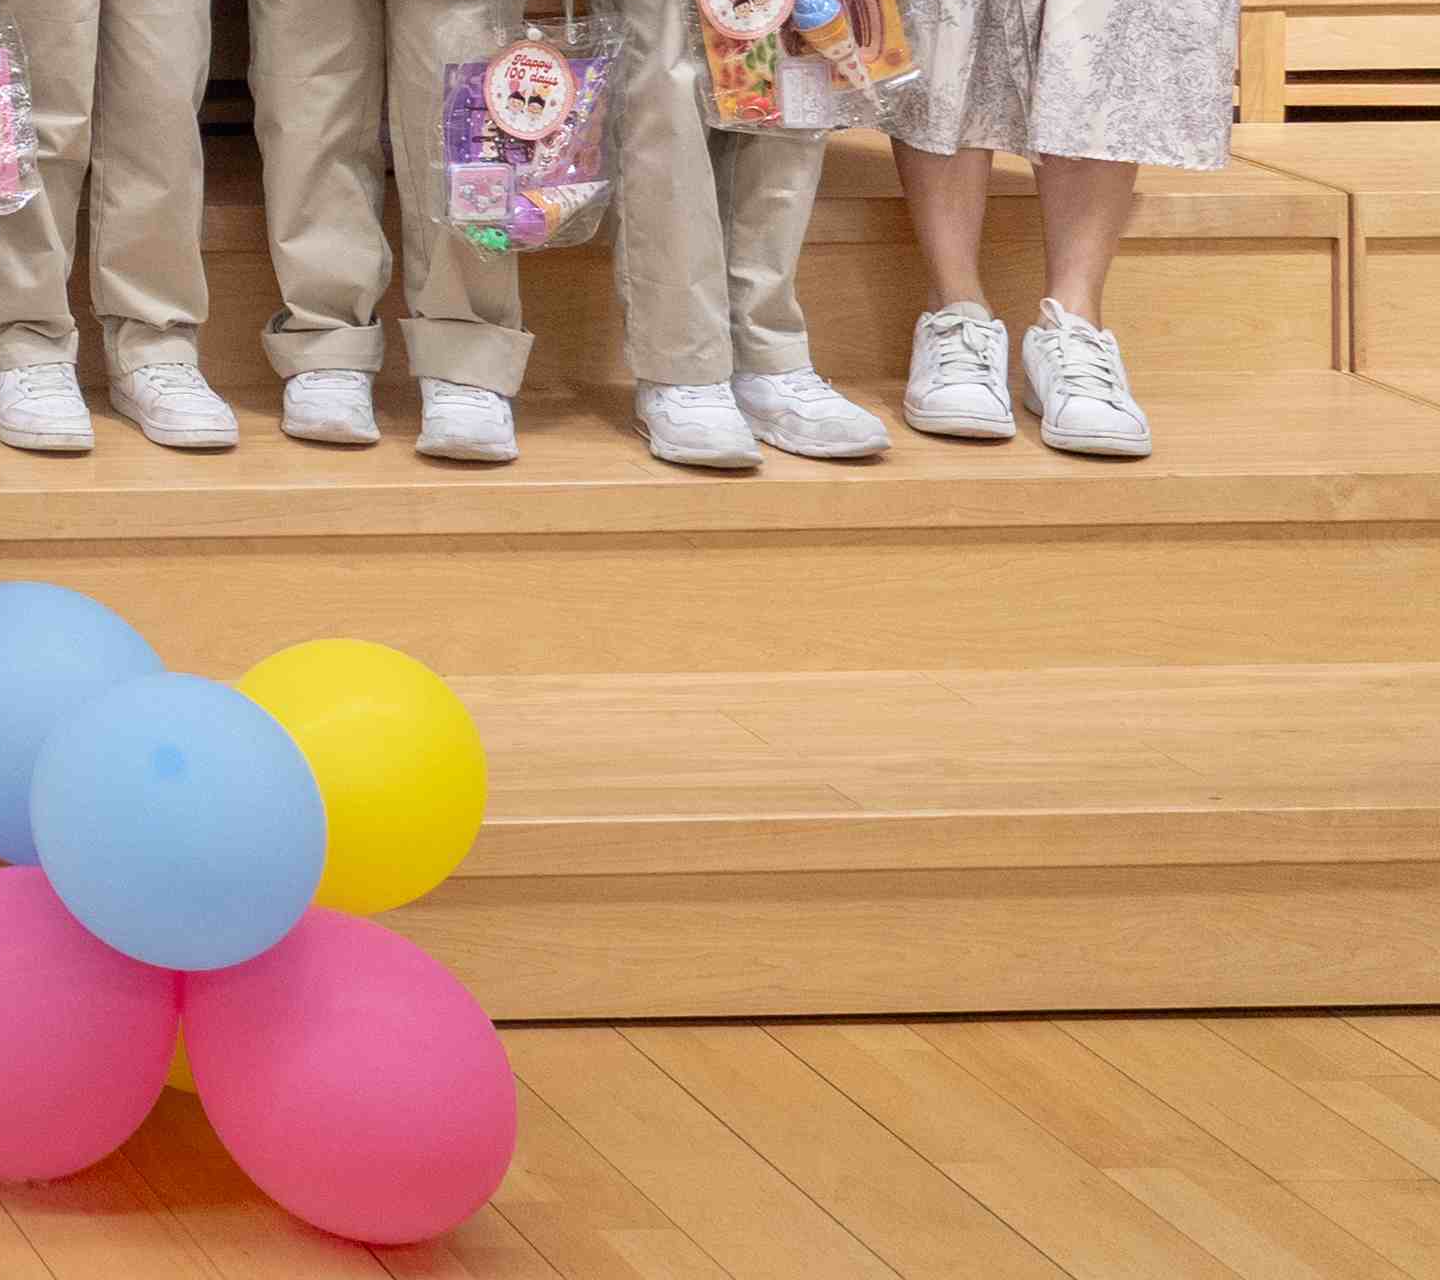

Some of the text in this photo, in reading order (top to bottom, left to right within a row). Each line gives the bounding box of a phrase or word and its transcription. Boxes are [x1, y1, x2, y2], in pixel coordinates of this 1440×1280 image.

[511, 53, 554, 72] Happy
[504, 66, 560, 88] 100 days
